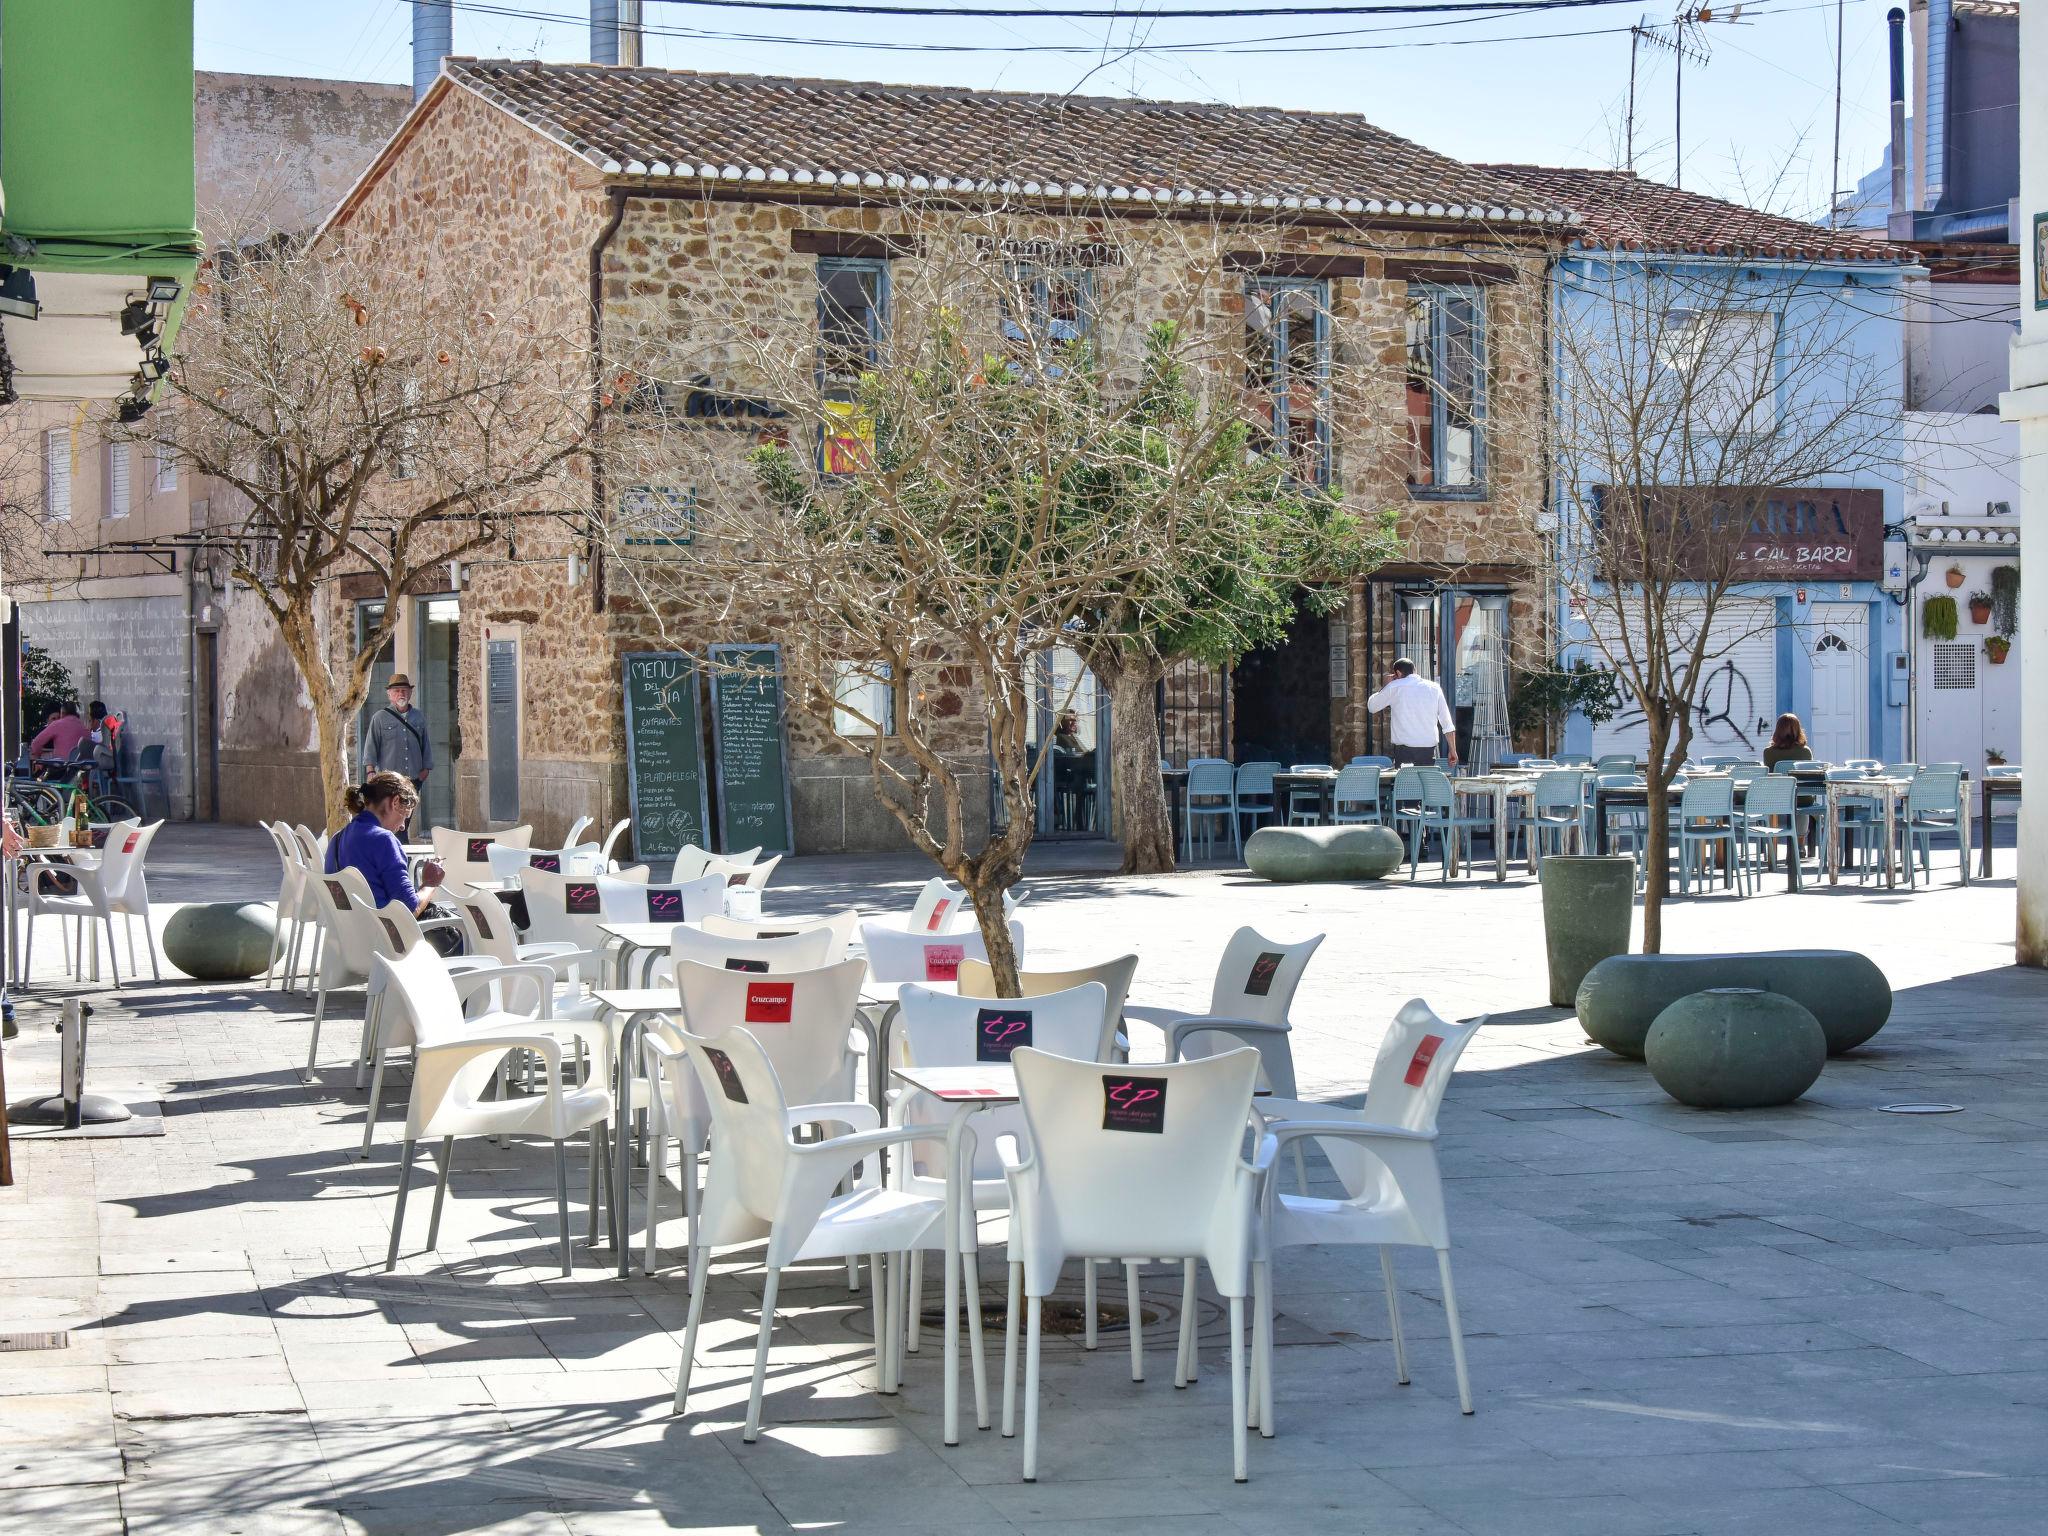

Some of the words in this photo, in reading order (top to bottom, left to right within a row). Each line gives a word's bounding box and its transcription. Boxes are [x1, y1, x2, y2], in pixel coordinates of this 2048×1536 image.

[1754, 546, 1789, 561] CAL
[1796, 546, 1852, 563] BARRI
[1841, 586, 1849, 598] 2
[632, 660, 676, 679] MENU
[645, 683, 660, 691] DEL
[570, 886, 597, 903] tp
[651, 893, 679, 910] tp
[751, 995, 787, 1005] Cruzcampo
[983, 1015, 1027, 1042] tp
[1109, 1081, 1160, 1109] tp
